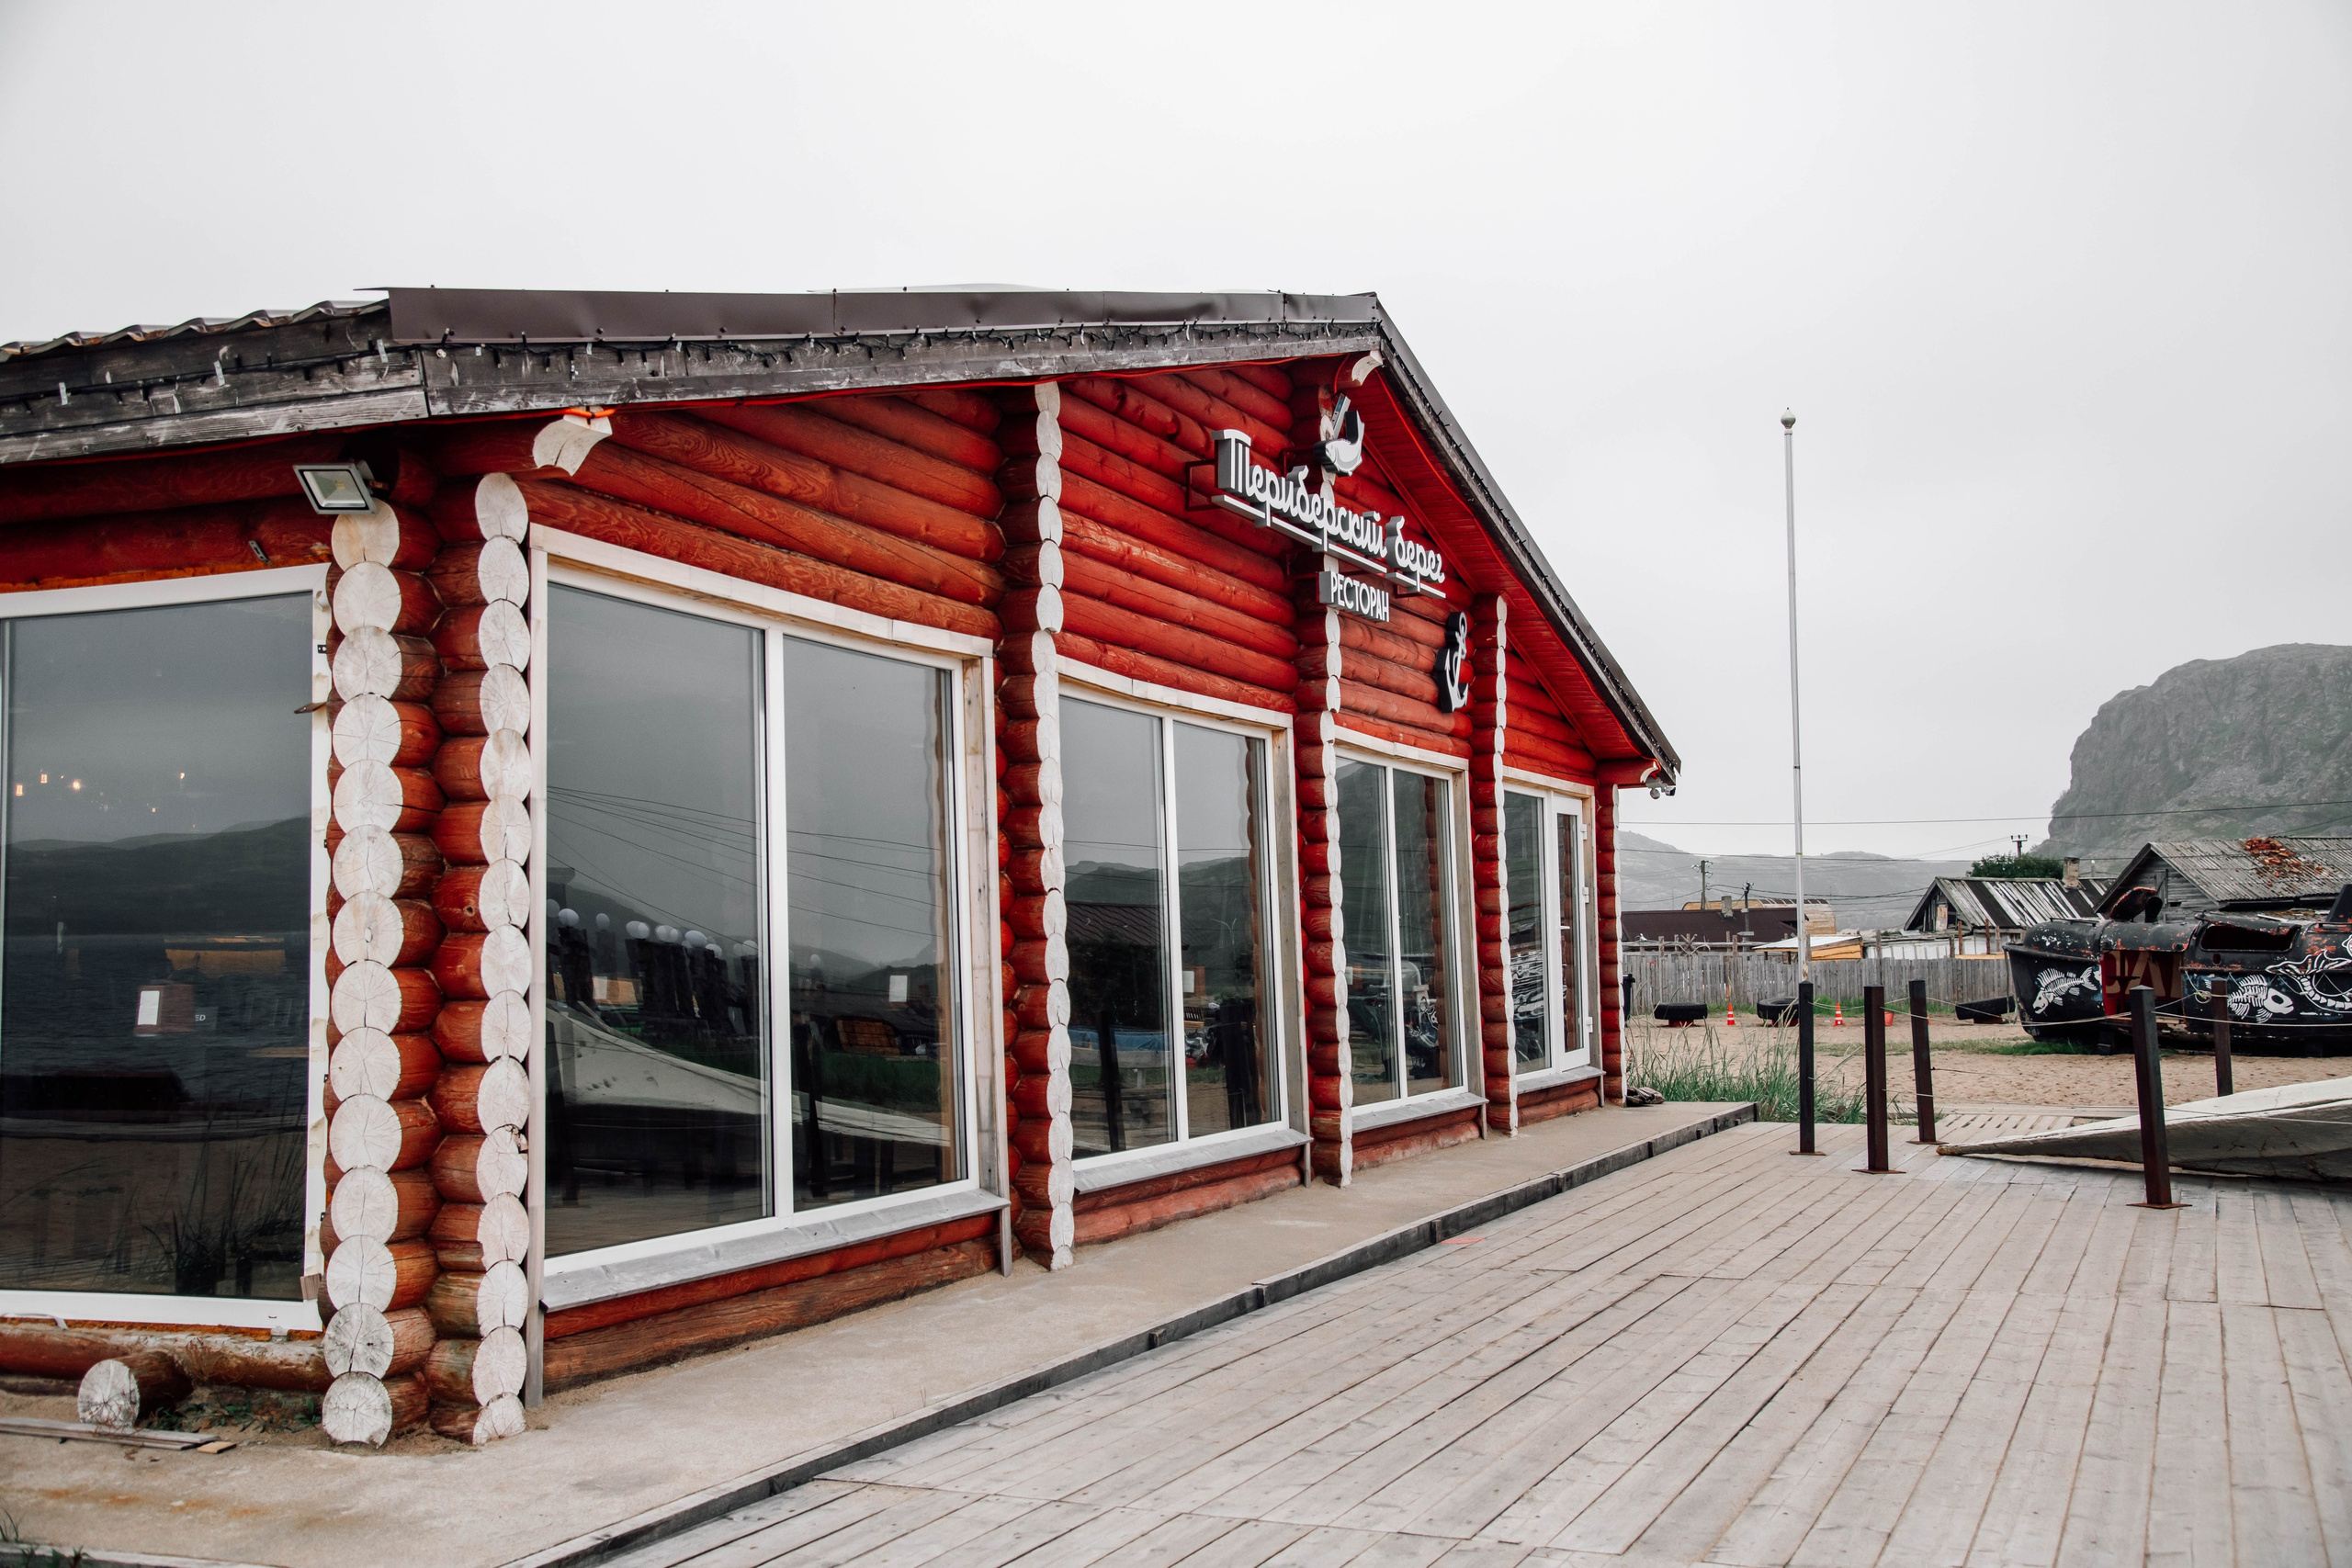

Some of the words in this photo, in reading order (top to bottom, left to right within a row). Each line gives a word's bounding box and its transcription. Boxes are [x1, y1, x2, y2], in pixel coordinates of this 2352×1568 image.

[1215, 429, 1388, 558] Териберский
[1391, 516, 1445, 592] берег
[1328, 570, 1390, 623] РЕСТОРАН
